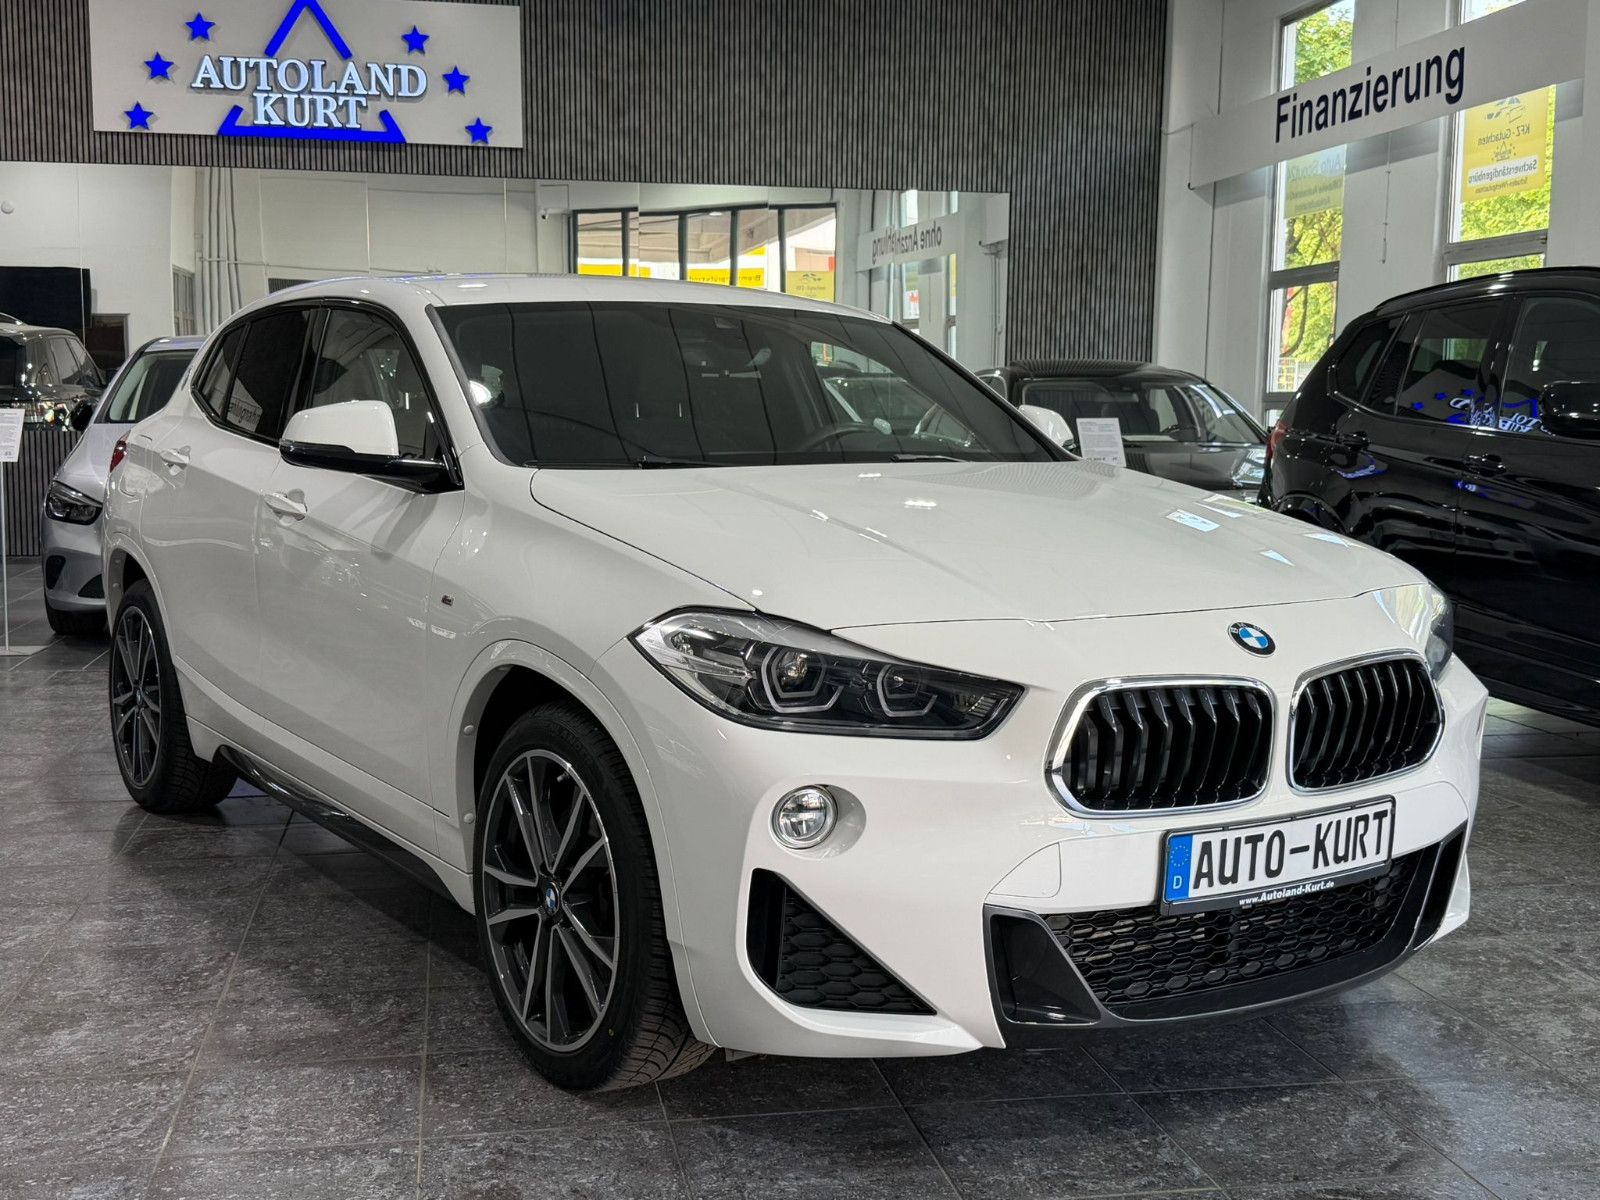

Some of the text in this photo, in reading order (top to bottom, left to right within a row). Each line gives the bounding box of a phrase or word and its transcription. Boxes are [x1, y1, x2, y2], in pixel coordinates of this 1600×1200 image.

[191, 54, 428, 98] AUTOLAND
[253, 92, 368, 129] KURT
[1275, 47, 1466, 143] Finanzierung
[1172, 875, 1182, 890] D
[1239, 881, 1335, 905] www.Autoland-Kurt.de
